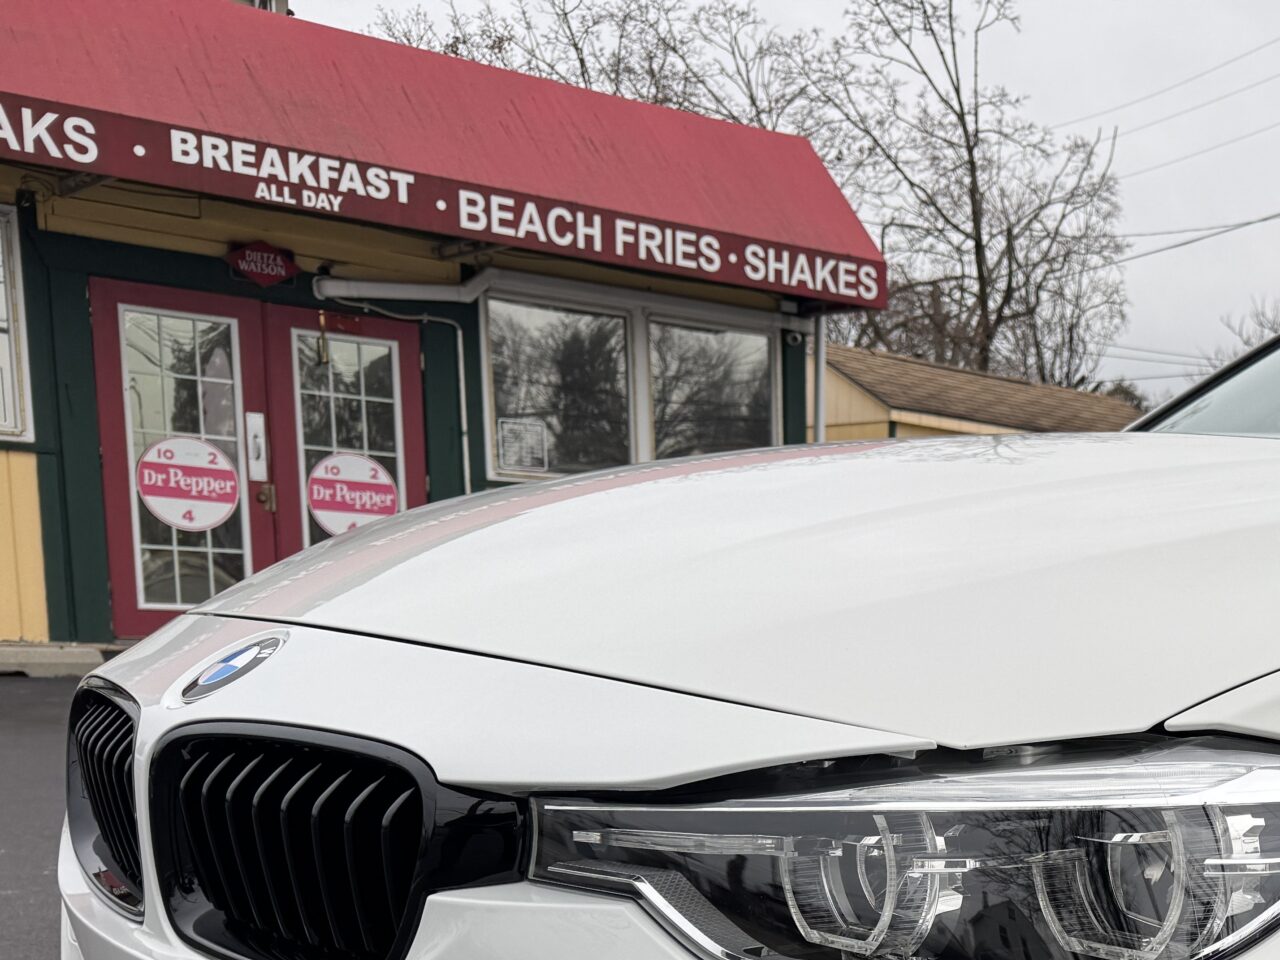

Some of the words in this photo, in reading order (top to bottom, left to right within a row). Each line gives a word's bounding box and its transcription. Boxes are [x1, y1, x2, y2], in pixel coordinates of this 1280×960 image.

[255, 182, 297, 205] ALL
[302, 189, 343, 213] DAY
[170, 129, 415, 204] BREAKFAST
[458, 189, 602, 252] BEACH
[614, 218, 722, 273] FRIES
[744, 244, 880, 301] SHAKES
[238, 258, 286, 277] WATSON
[245, 250, 274, 266] DIETZ
[157, 448, 175, 460] 10
[207, 452, 218, 465] 2
[143, 469, 166, 486] Dr
[168, 468, 235, 496] Pepper
[324, 465, 340, 476] 10
[369, 467, 379, 480] 2
[312, 484, 333, 501] Dr
[335, 483, 394, 510] Pepper
[182, 510, 195, 523] 4
